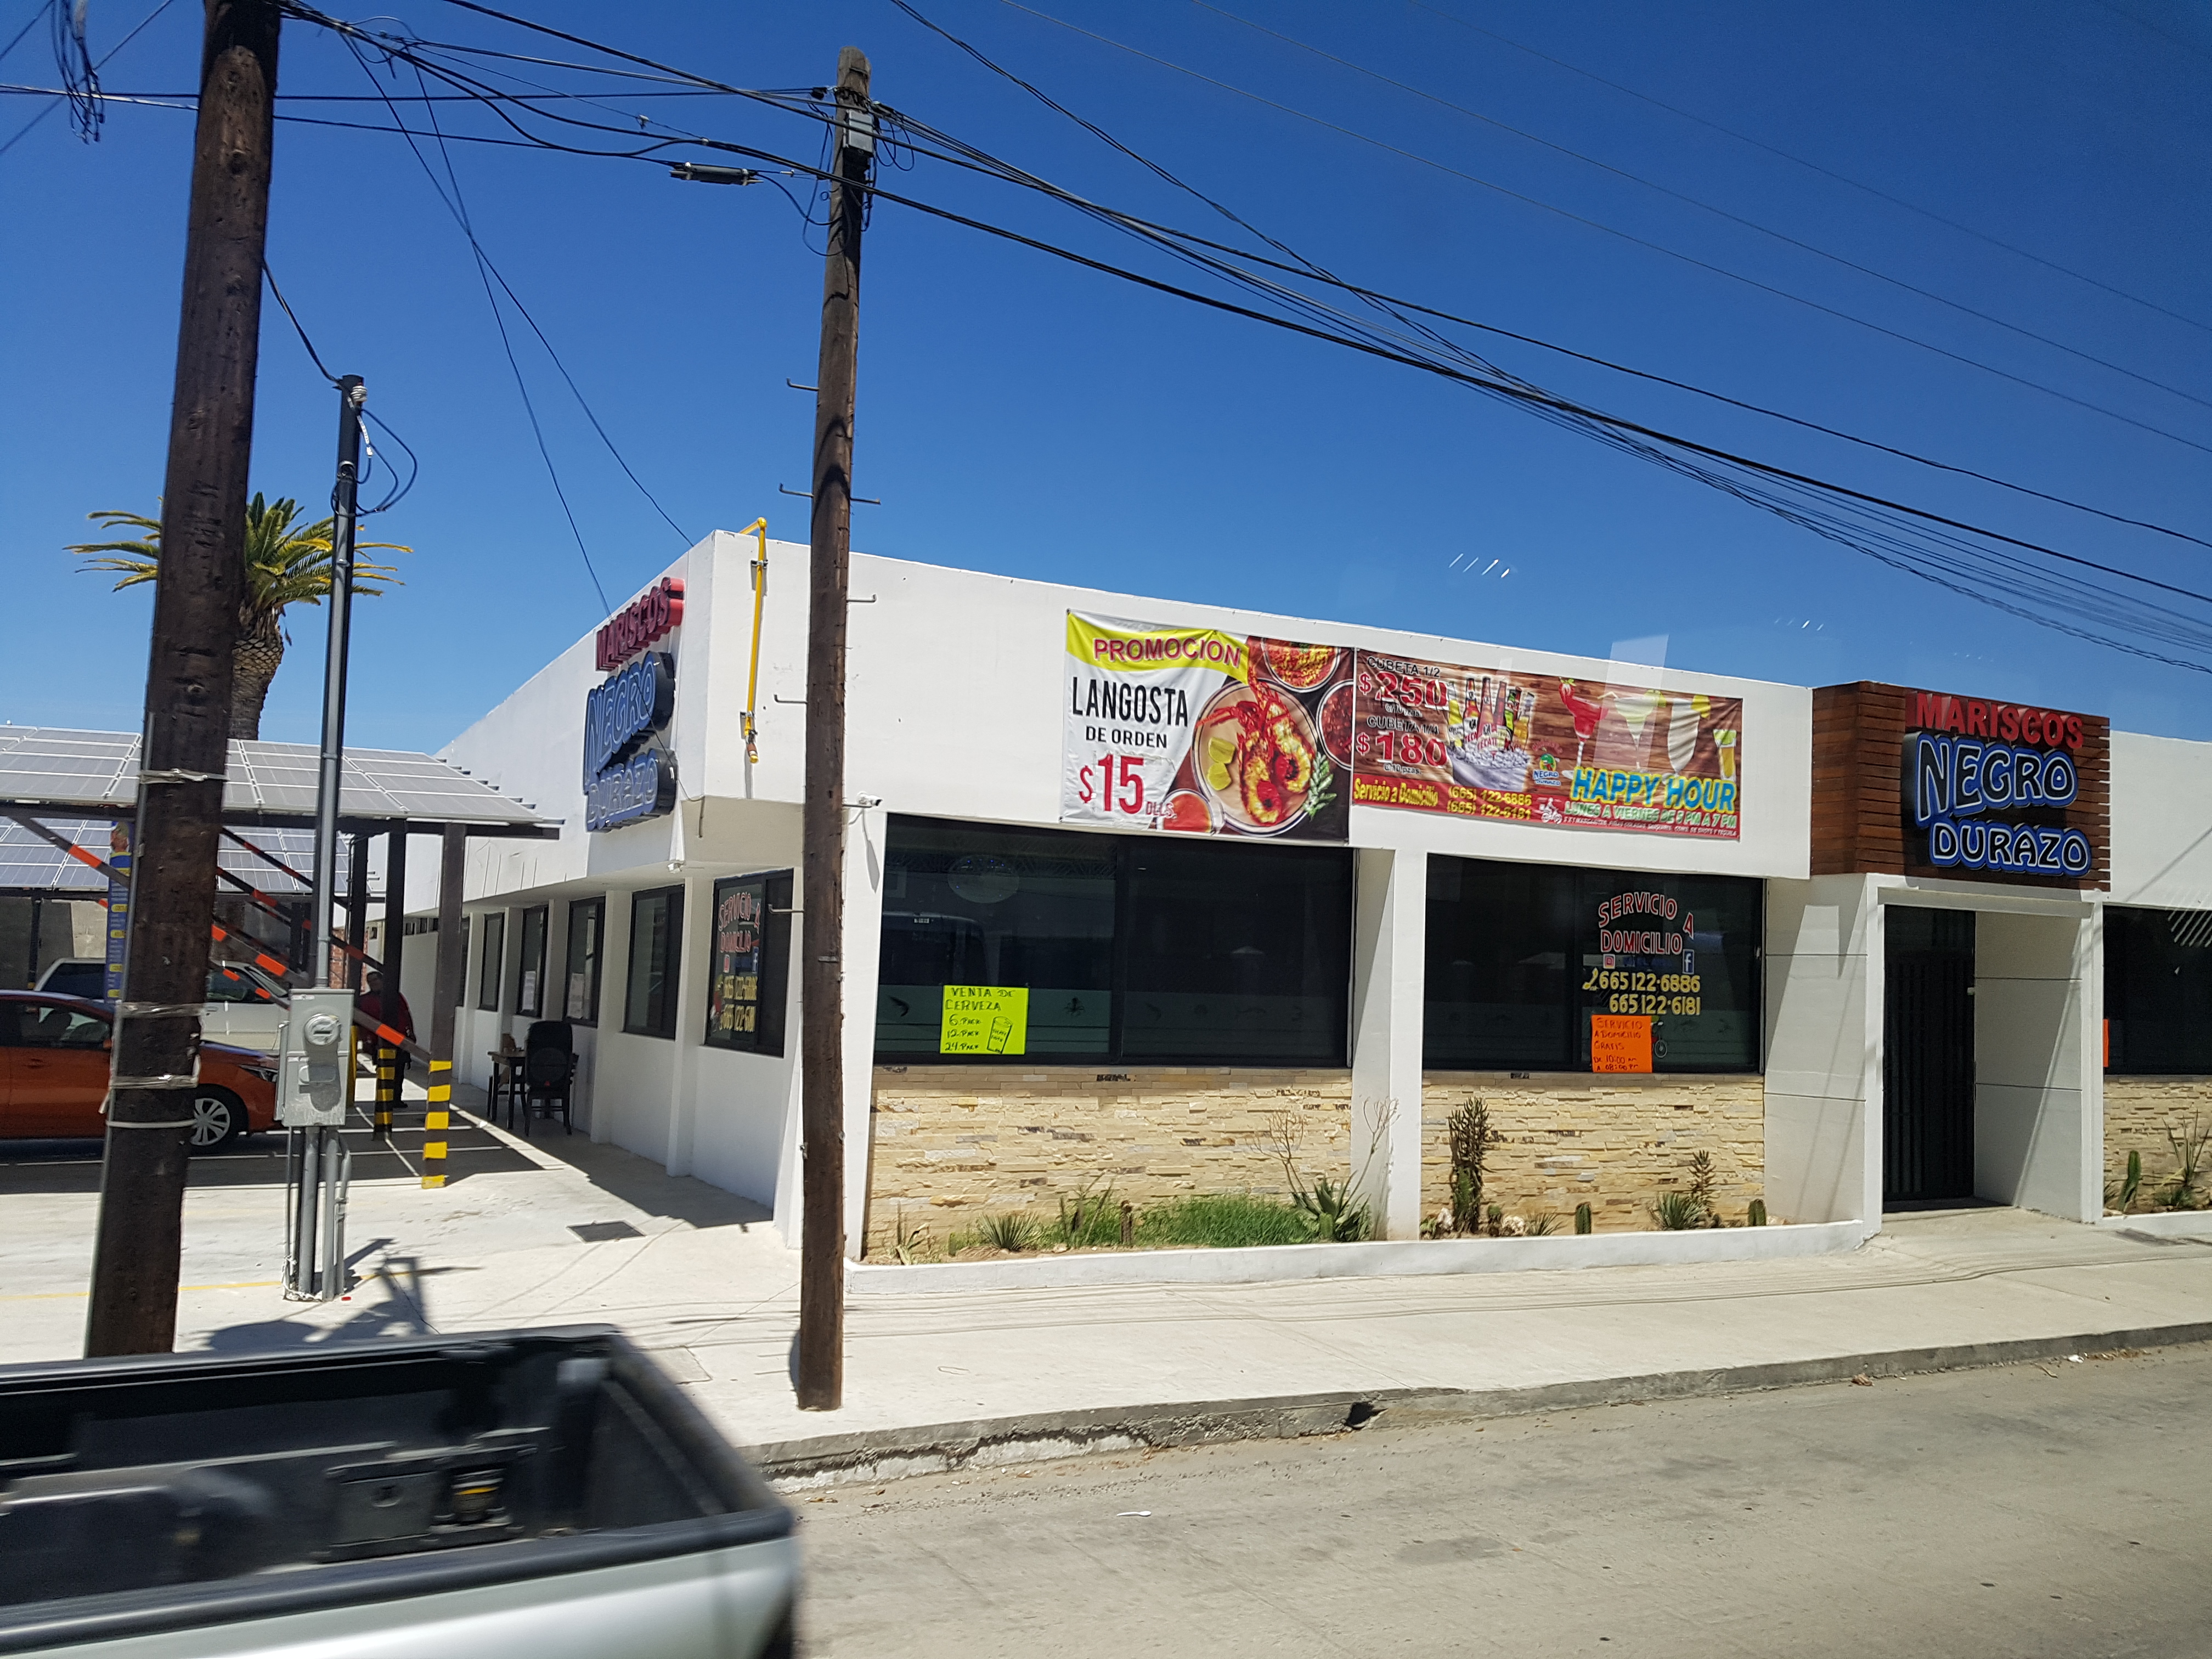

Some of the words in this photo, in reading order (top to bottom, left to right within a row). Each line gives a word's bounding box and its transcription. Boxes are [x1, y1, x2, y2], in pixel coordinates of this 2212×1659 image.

[596, 577, 681, 671] MARISCOS
[1093, 637, 1240, 668] PROMOCION
[1367, 657, 1419, 675] CUBETA
[1423, 666, 1441, 678] 1/2
[585, 654, 658, 775] NEGRO
[1072, 676, 1188, 727] LANGOSTA
[1367, 715, 1420, 733] CUBETA
[1916, 692, 2084, 749] MARISCOS
[1085, 725, 1107, 742] DE
[1111, 729, 1167, 748] ORDEN
[1533, 770, 1559, 779] NEGRO
[1917, 738, 2075, 823] NEGRO
[586, 754, 659, 826] DURAZO
[1353, 777, 1390, 802] Servicio
[1390, 786, 1398, 803] a
[1448, 786, 1477, 801] (665)
[1481, 789, 1532, 806] 122-6886
[1571, 766, 1661, 806] HAPPY
[1663, 776, 1736, 814] HOUR
[1447, 799, 1476, 815] (665)
[1480, 804, 1531, 820] 122-6181
[1565, 800, 1601, 817] LUNES
[1602, 805, 1612, 819] A
[1613, 805, 1660, 822] VIERNES
[1660, 809, 1676, 824] DE
[1684, 811, 1702, 826] PM
[1702, 812, 1711, 827] A
[1711, 813, 1720, 827] 7
[1720, 814, 1737, 829] PM
[1932, 821, 2090, 872] DURAZO
[718, 890, 752, 932] SERVICIO
[754, 902, 761, 934] A
[1598, 891, 1678, 928] SERVICIO
[1683, 911, 1694, 940] A
[1600, 929, 1683, 955] DOMICILIO
[945, 999, 1001, 1011] CERVEZA
[951, 988, 992, 997] VENTA
[998, 988, 1015, 997] DE
[1596, 1018, 1642, 1029] SERVICIO
[1594, 1041, 1624, 1050] GRATIS
[1606, 1055, 1626, 1064] 10:00
